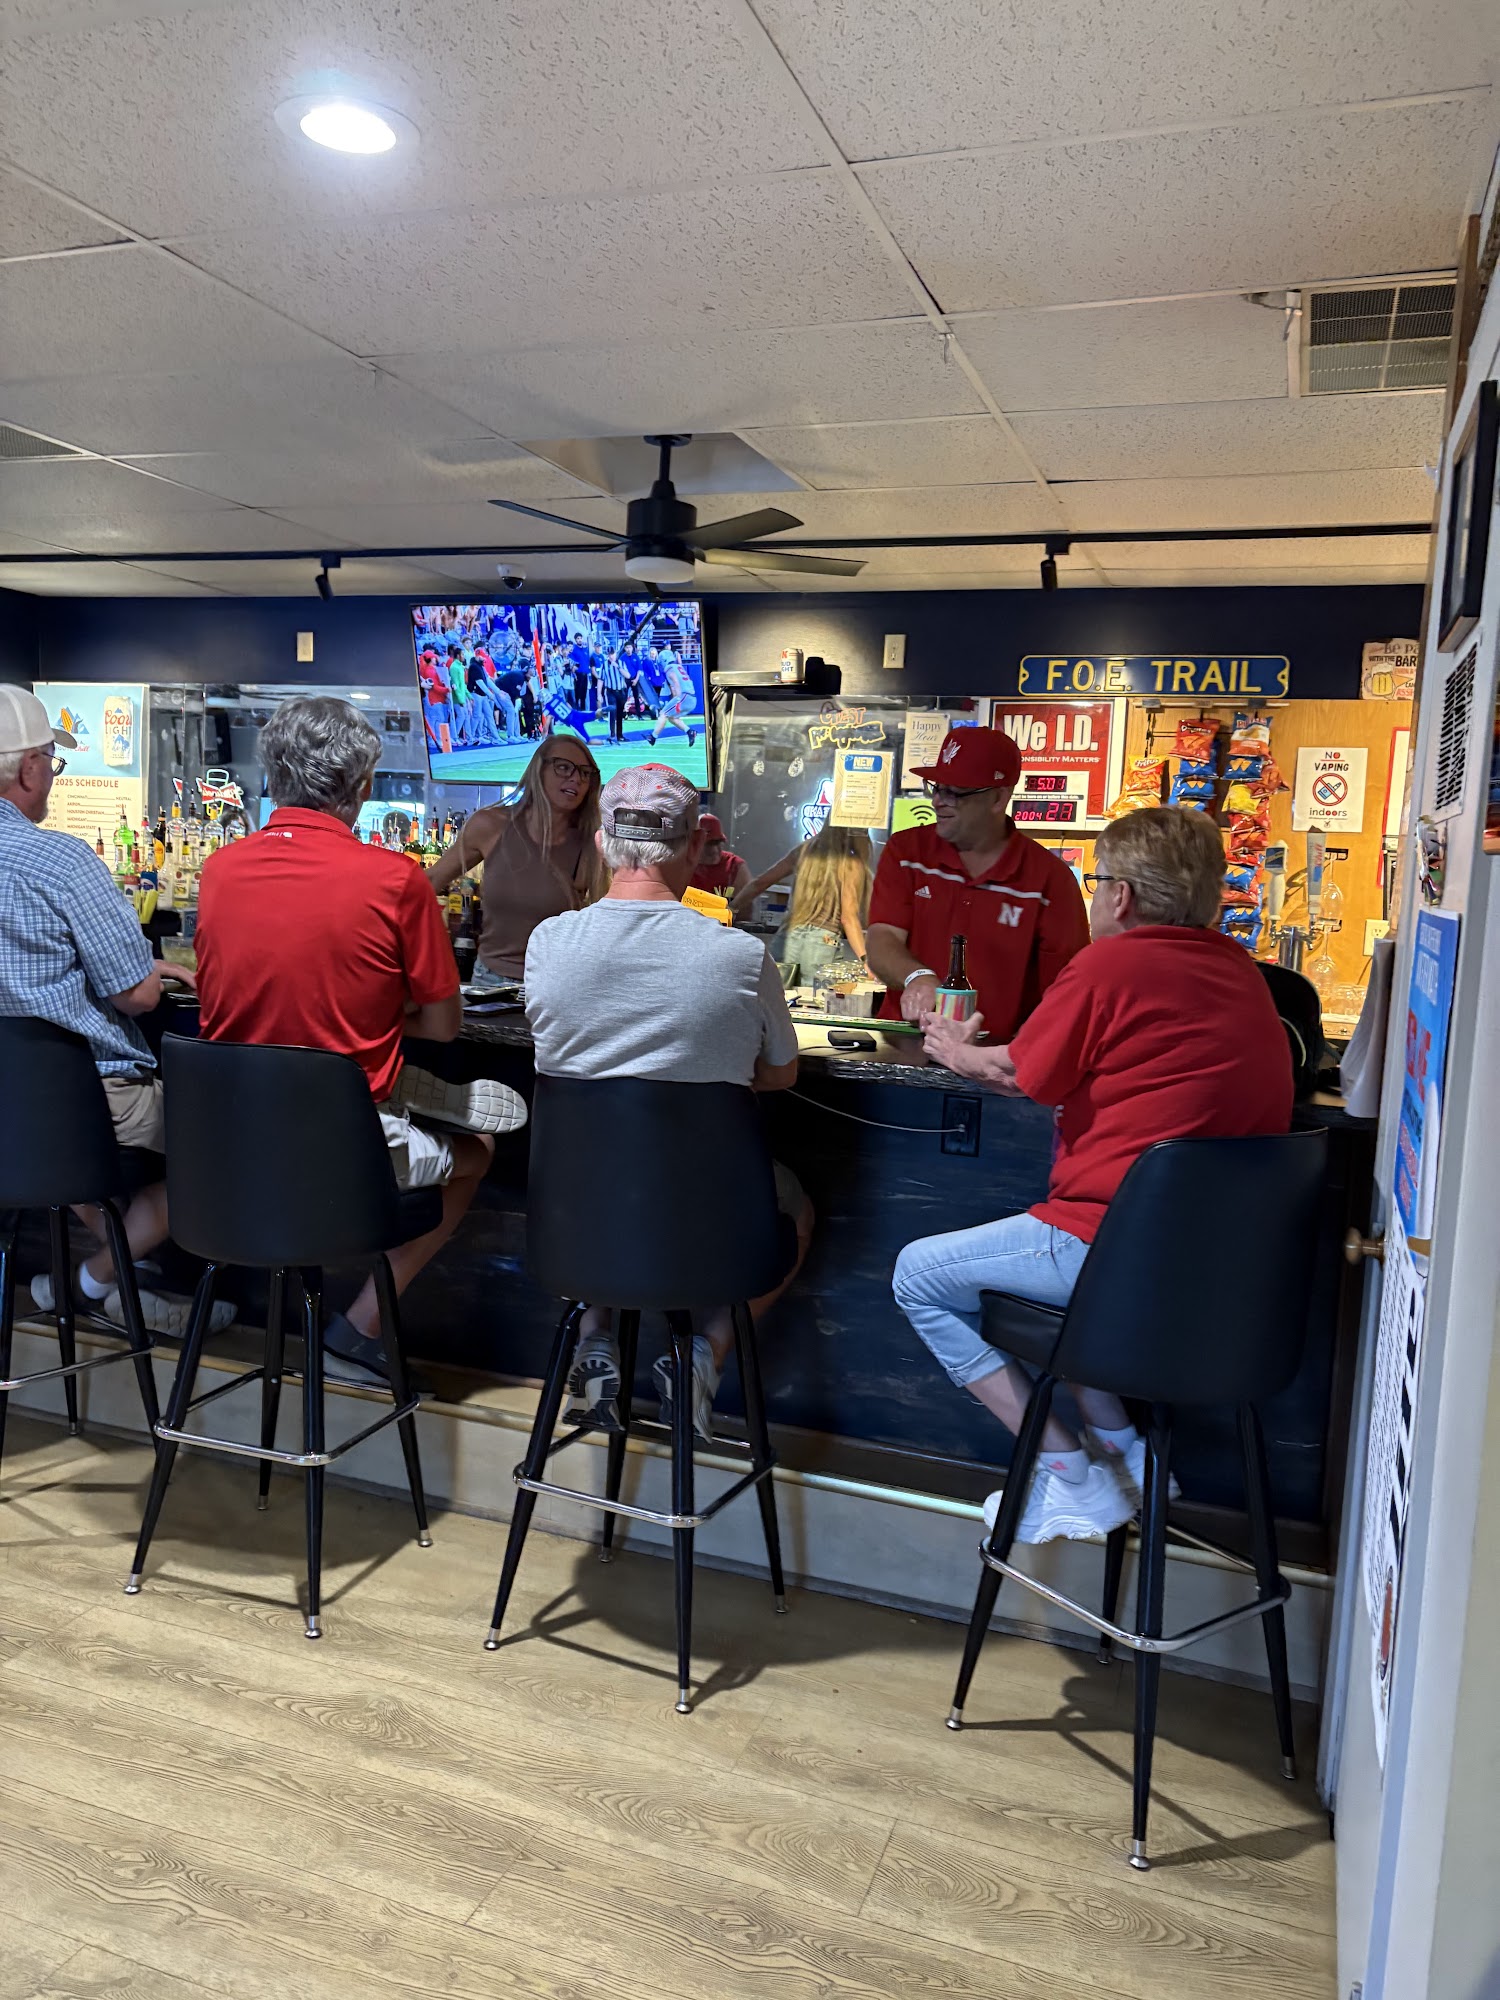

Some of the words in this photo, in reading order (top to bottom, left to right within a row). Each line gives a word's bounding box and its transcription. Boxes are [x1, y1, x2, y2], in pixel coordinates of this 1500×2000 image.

[1395, 655, 1418, 667] BAR
[1046, 660, 1133, 692] F.O.E.
[1151, 660, 1262, 692] TRAIL
[912, 720, 941, 732] Happy
[1003, 714, 1048, 752] We
[1055, 714, 1099, 752] I.D.
[1325, 752, 1341, 760] NO
[1314, 762, 1350, 772] VAPING
[55, 778, 74, 787] 2025
[75, 779, 119, 788] SCHEDULE
[1014, 811, 1043, 821] 2004
[1045, 802, 1074, 821] 27
[1309, 808, 1348, 817] indoors
[997, 902, 1024, 928] N
